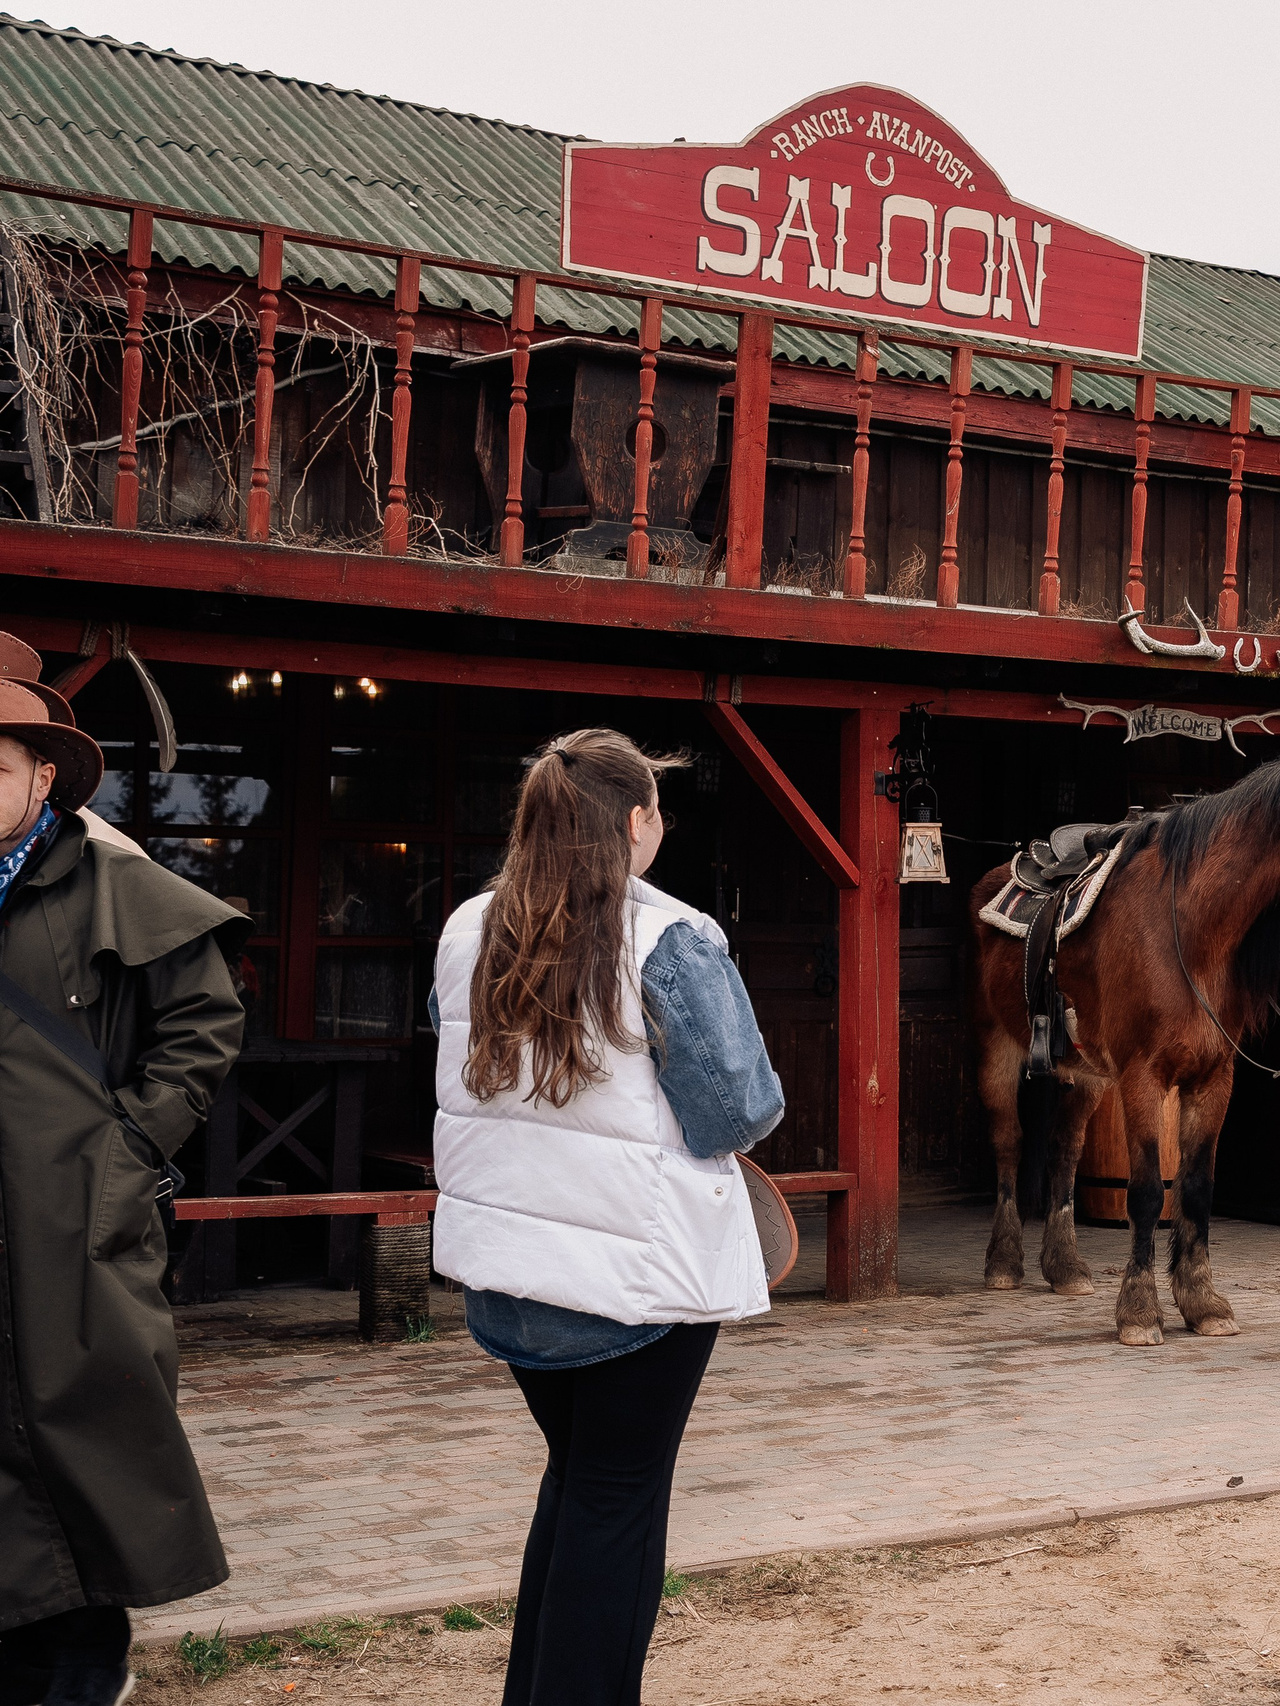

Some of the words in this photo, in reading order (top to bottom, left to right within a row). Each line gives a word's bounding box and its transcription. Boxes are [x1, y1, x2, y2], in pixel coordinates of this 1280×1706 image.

[771, 107, 854, 162] RANCH
[865, 110, 974, 190] AVANPOST
[698, 165, 1052, 327] SALOON
[1133, 709, 1217, 737] WELCOME
